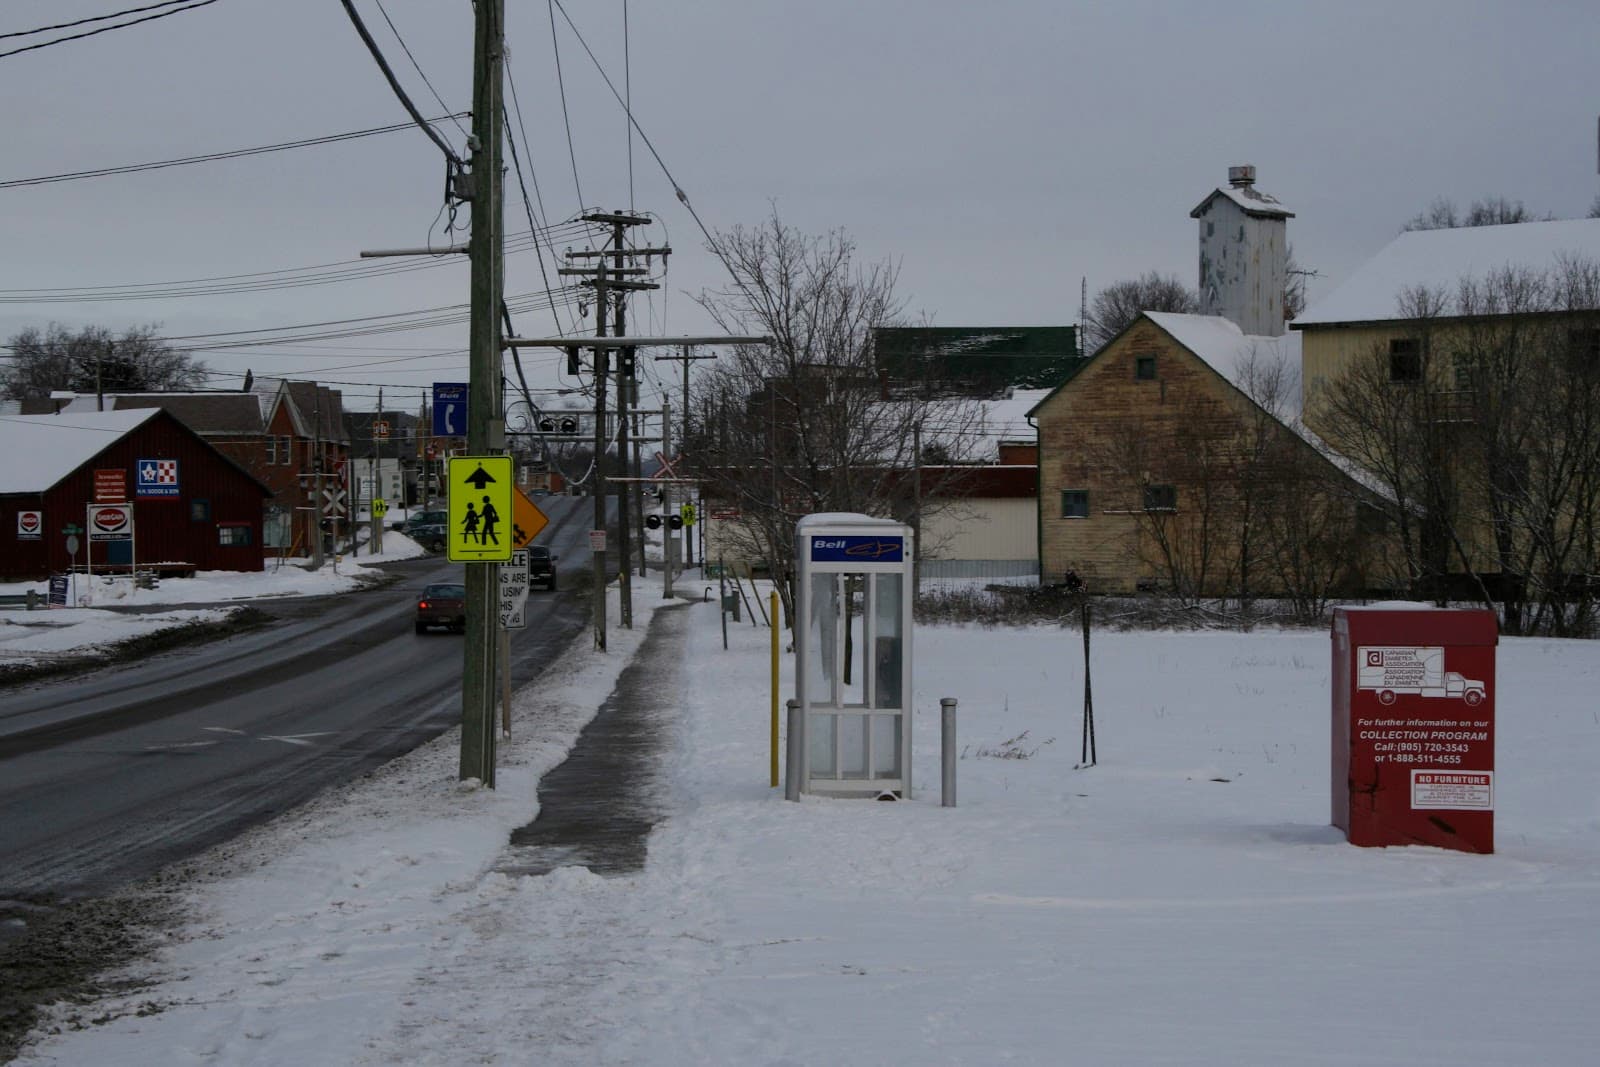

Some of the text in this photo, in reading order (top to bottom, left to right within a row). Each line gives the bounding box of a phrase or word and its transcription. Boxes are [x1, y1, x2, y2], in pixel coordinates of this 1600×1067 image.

[814, 540, 846, 549] Bell
[512, 573, 526, 583] ARE
[1406, 719, 1457, 727] information
[1360, 731, 1488, 741] COLLECTION PROGRAM
[1424, 743, 1469, 752] 720-3543
[1388, 754, 1461, 764] 1-888-511-4555
[1418, 775, 1487, 785] NO FURNITURE
